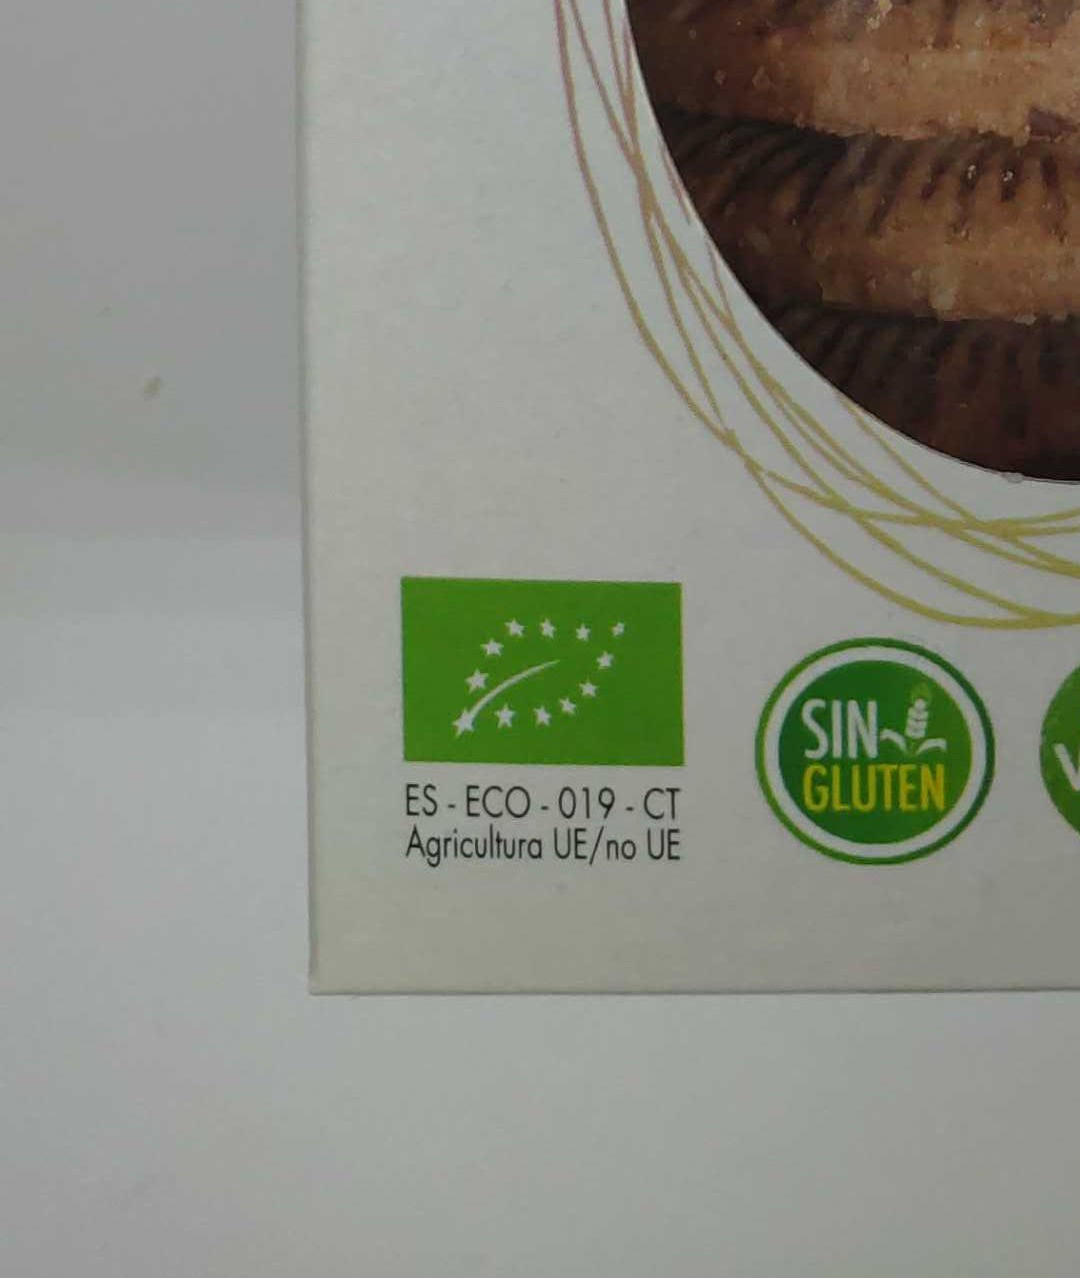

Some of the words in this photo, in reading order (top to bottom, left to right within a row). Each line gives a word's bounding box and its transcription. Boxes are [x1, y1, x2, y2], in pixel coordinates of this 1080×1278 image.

[800, 698, 878, 760] SIN
[803, 763, 946, 813] GLUTEN
[405, 823, 543, 869] Agricultura
[552, 825, 637, 867] UE/no
[646, 828, 682, 862] UE
